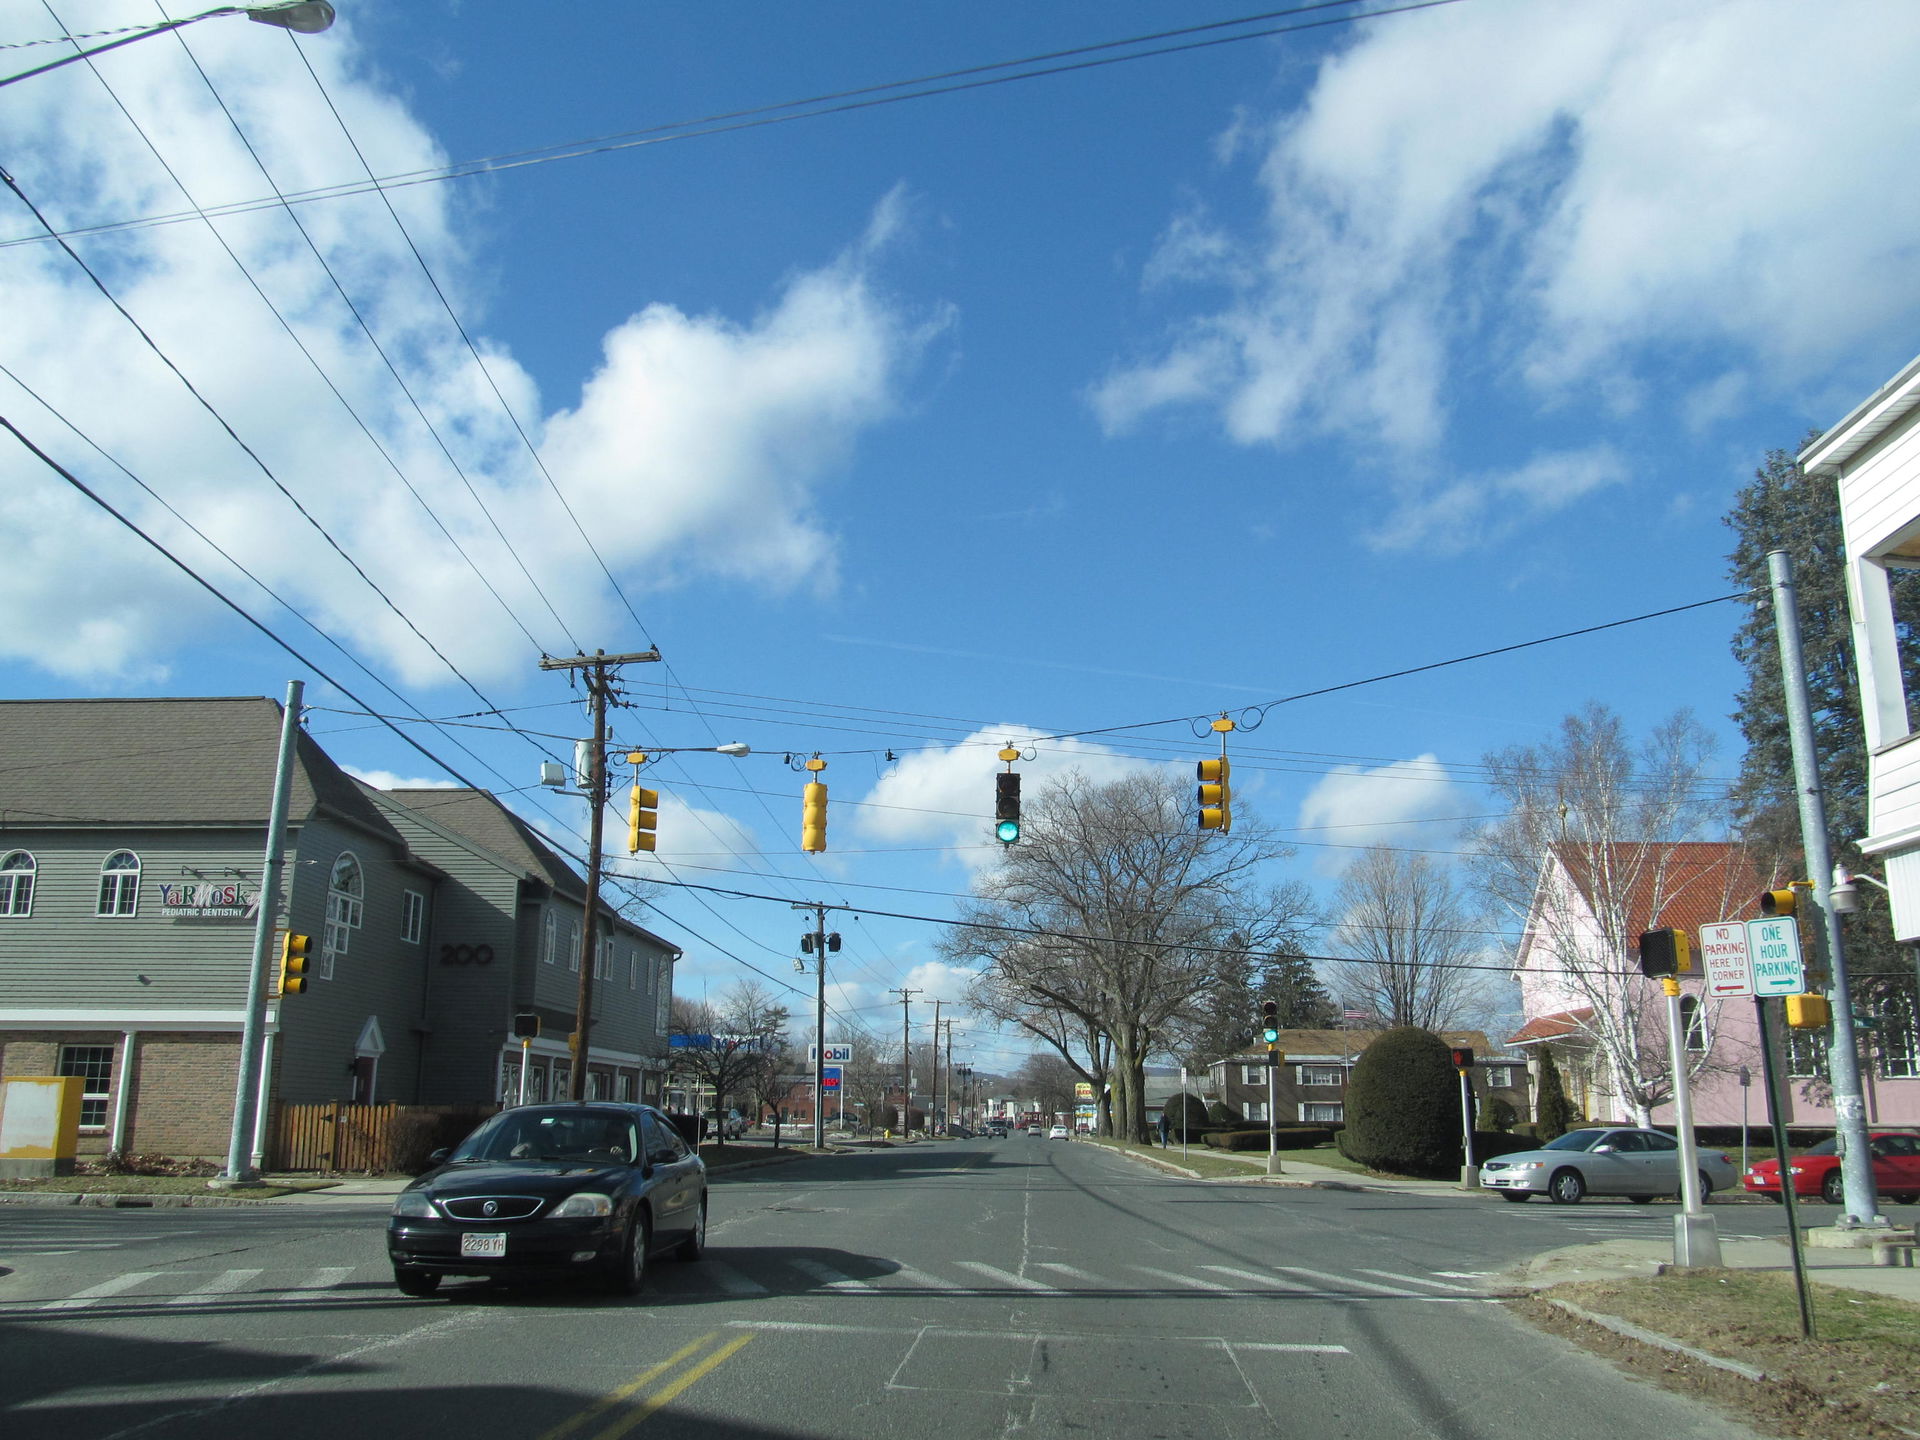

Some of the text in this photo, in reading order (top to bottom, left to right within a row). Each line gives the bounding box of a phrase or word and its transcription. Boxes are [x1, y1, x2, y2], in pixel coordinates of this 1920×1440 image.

[161, 908, 243, 917] PEDIATRIC DENTISTRY
[1716, 928, 1729, 940] NO
[1761, 926, 1783, 941] ONE
[441, 943, 494, 967] 200
[1705, 942, 1745, 956] PARKING
[1760, 943, 1788, 959] HOUR
[1709, 957, 1744, 968] HERE TO
[1755, 960, 1798, 977] PARKING
[1712, 970, 1745, 981] CORNER
[464, 1239, 504, 1251] 2298 YH
